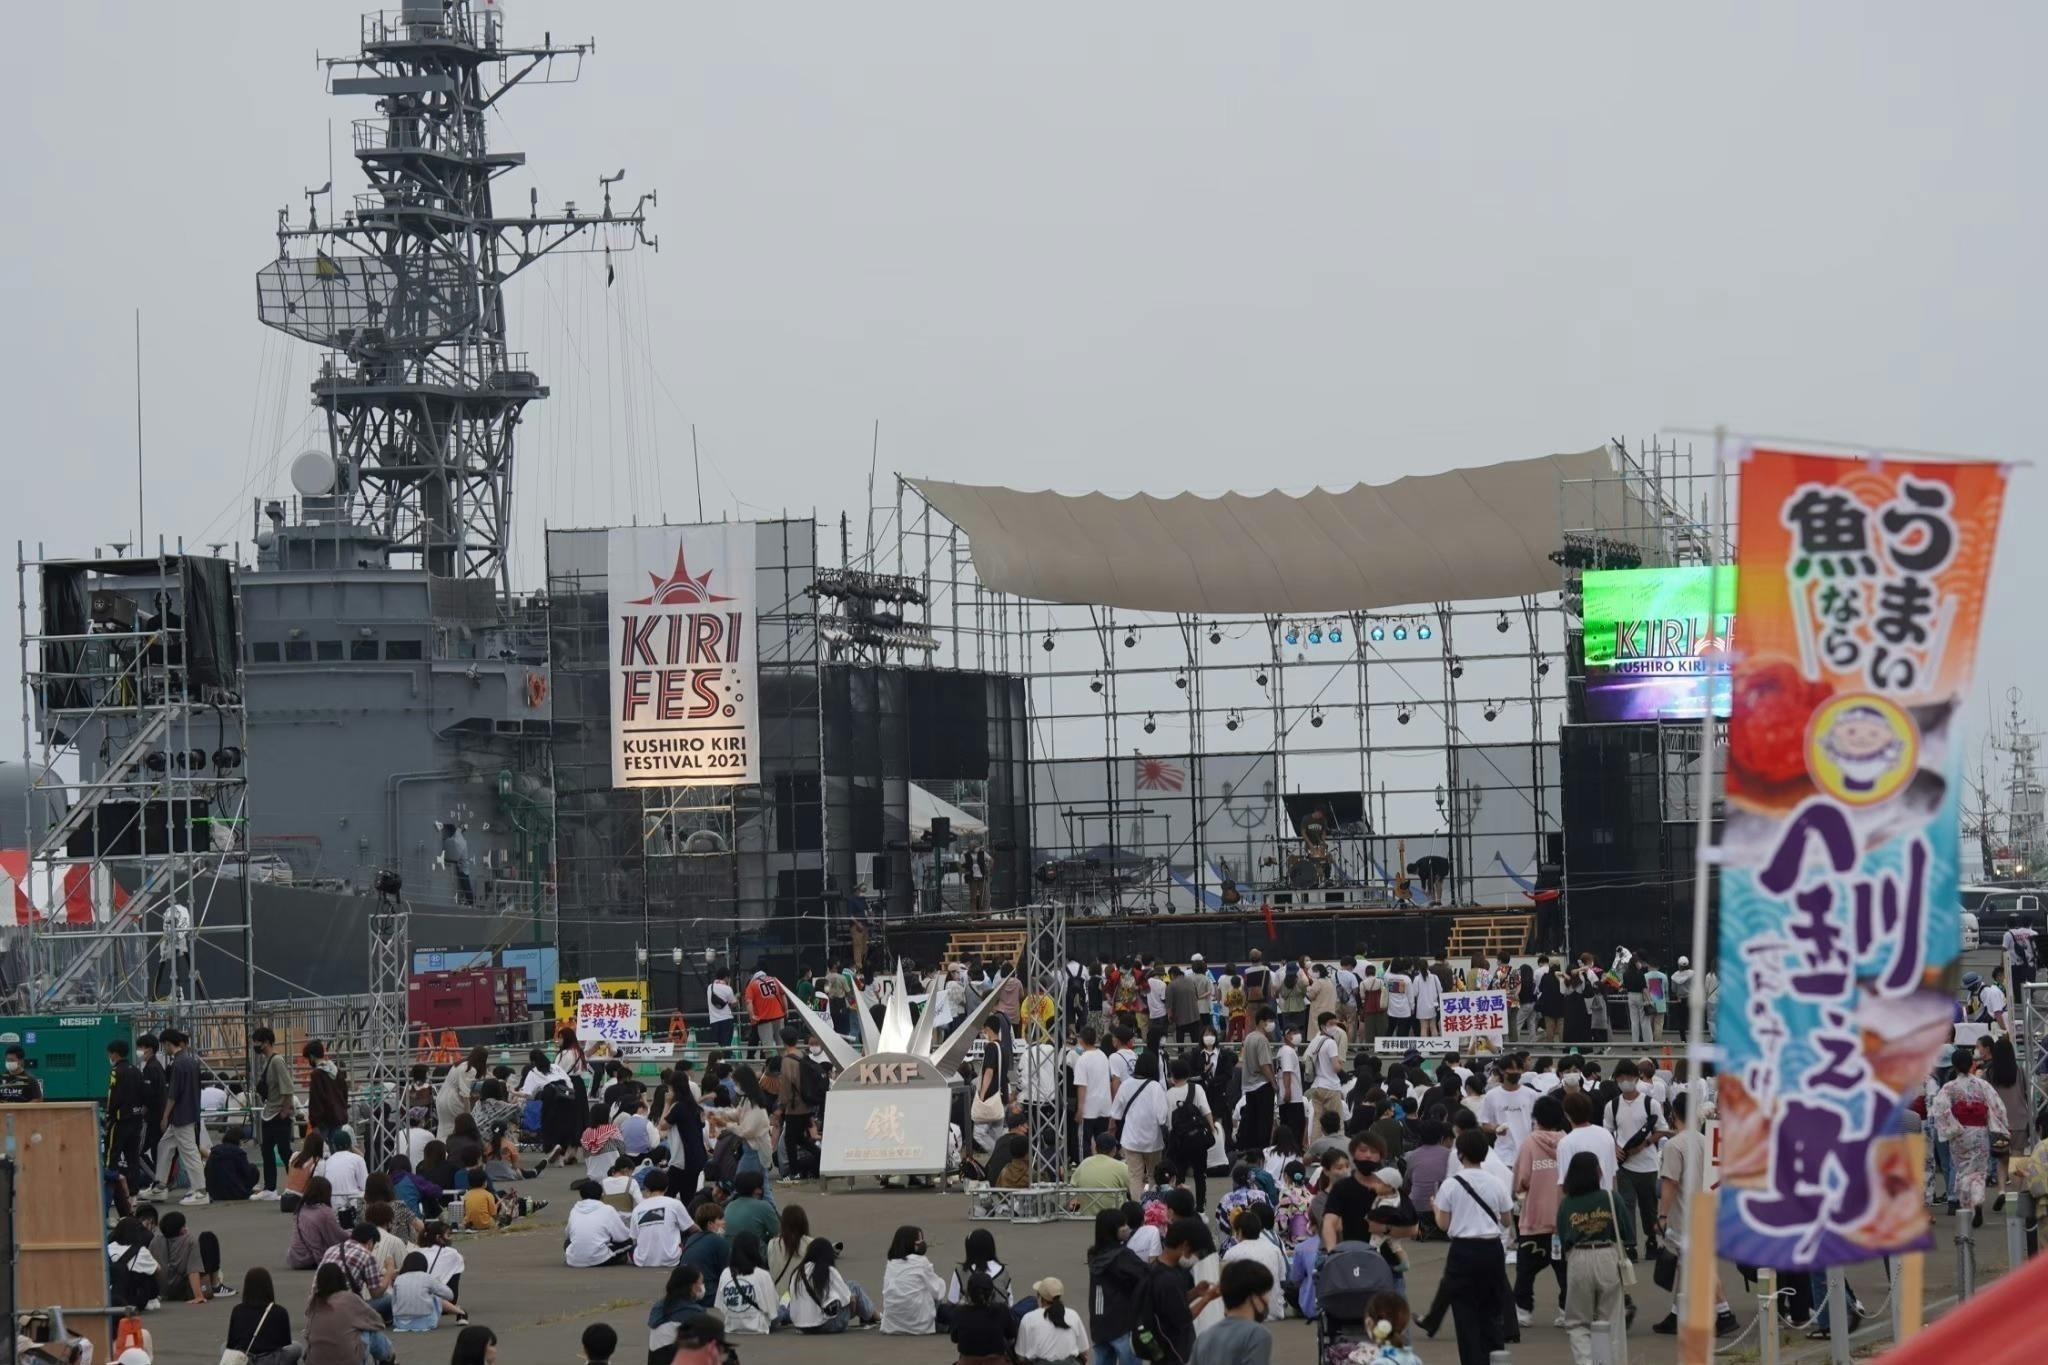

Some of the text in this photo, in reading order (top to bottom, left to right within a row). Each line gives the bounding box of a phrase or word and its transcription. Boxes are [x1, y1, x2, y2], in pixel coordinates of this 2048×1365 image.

[1870, 479, 1953, 690] うまい
[620, 611, 743, 667] KIRI
[1615, 616, 1698, 659] KIRI
[1614, 660, 1675, 673] KUSHIRO
[1678, 660, 1707, 672] KIRI
[623, 735, 747, 754] KUSHIRO KIRI
[623, 753, 748, 770] FESTIVAL 2021
[580, 1002, 637, 1019] 感染対策に
[1443, 995, 1505, 1015] 写真・動画
[581, 1018, 619, 1029] ご協力
[1443, 1014, 1504, 1033] 撮影禁止
[599, 1029, 638, 1040] ください
[860, 1062, 919, 1085] KKF
